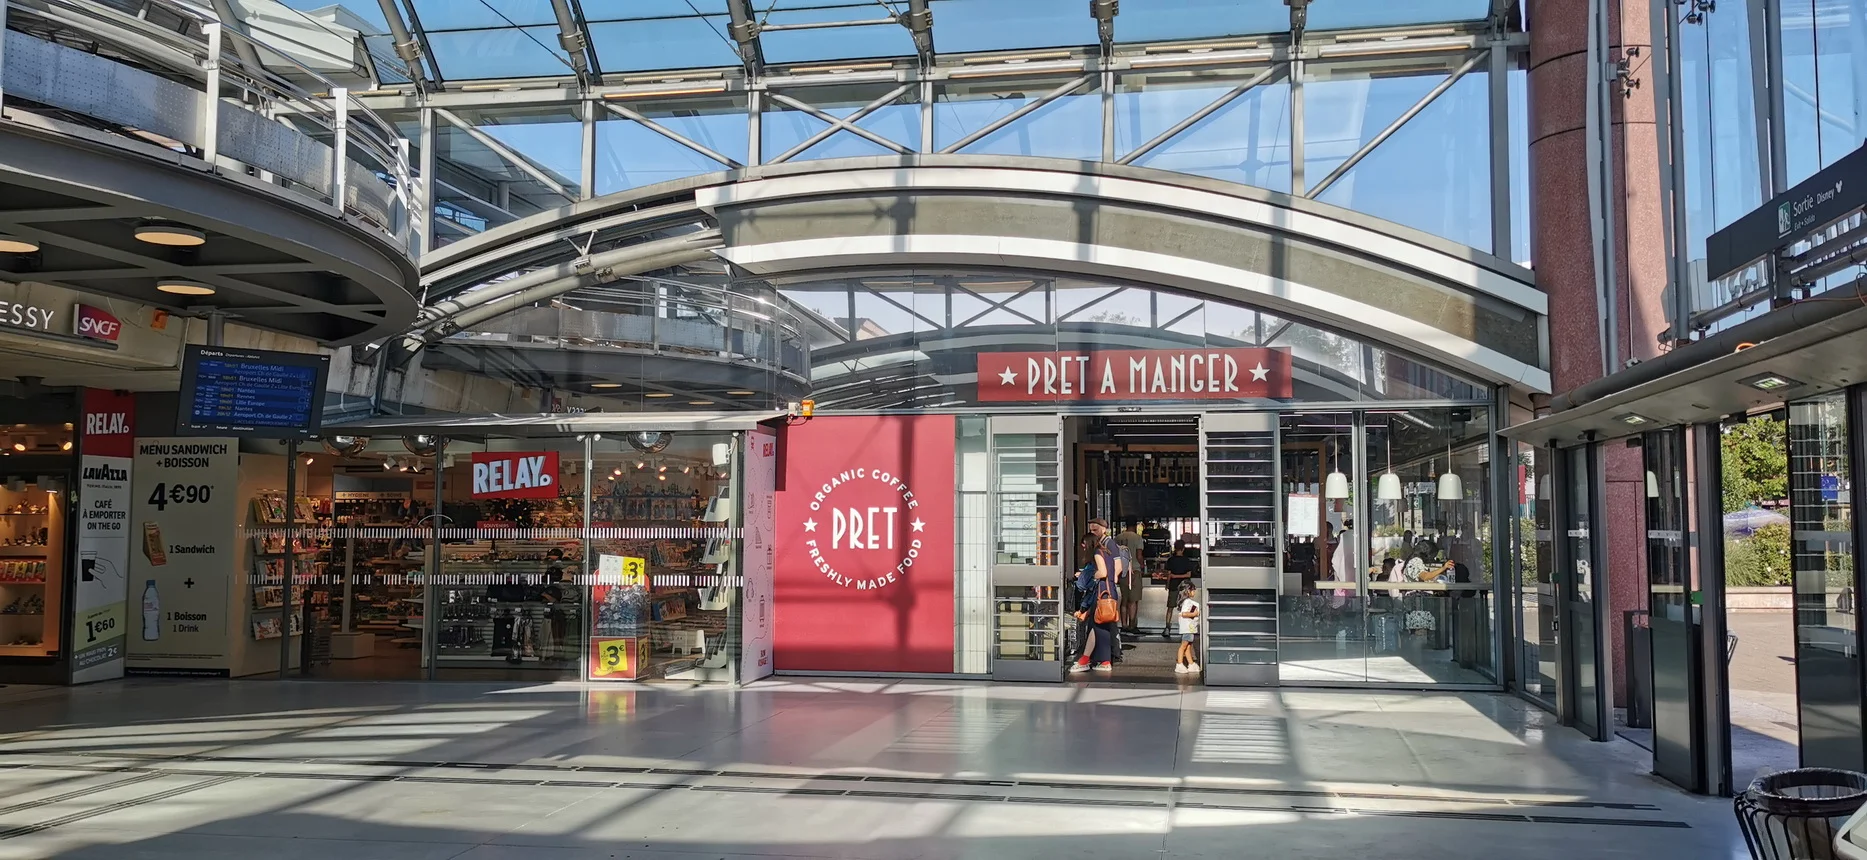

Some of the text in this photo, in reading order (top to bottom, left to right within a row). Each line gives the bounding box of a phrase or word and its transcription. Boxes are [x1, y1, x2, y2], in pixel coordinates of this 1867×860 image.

[1793, 188, 1834, 216] Sortie Disney
[79, 316, 118, 335] SNCF
[241, 363, 269, 371] Bruxelles
[1027, 354, 1238, 394] PRET A MANGER
[239, 375, 267, 383] Bruxelles
[86, 412, 124, 435] RELAY
[140, 444, 228, 455] MENU SANDWICH
[164, 458, 210, 468] BOISSON
[83, 464, 128, 481] LAVAZZA
[472, 455, 546, 494] RELAY
[810, 468, 918, 511] ORGANIC COFFEE
[94, 499, 112, 508] CAFÉ
[82, 509, 126, 519] À EMPORTER
[87, 522, 120, 530] ON THE GO
[832, 507, 898, 549] PRET
[169, 544, 215, 554] 1 Sandwich
[806, 539, 922, 590] FRESHLY MADE FOOD
[174, 612, 207, 621] Boisson
[86, 618, 115, 642] 1€60
[178, 624, 199, 633] Drink
